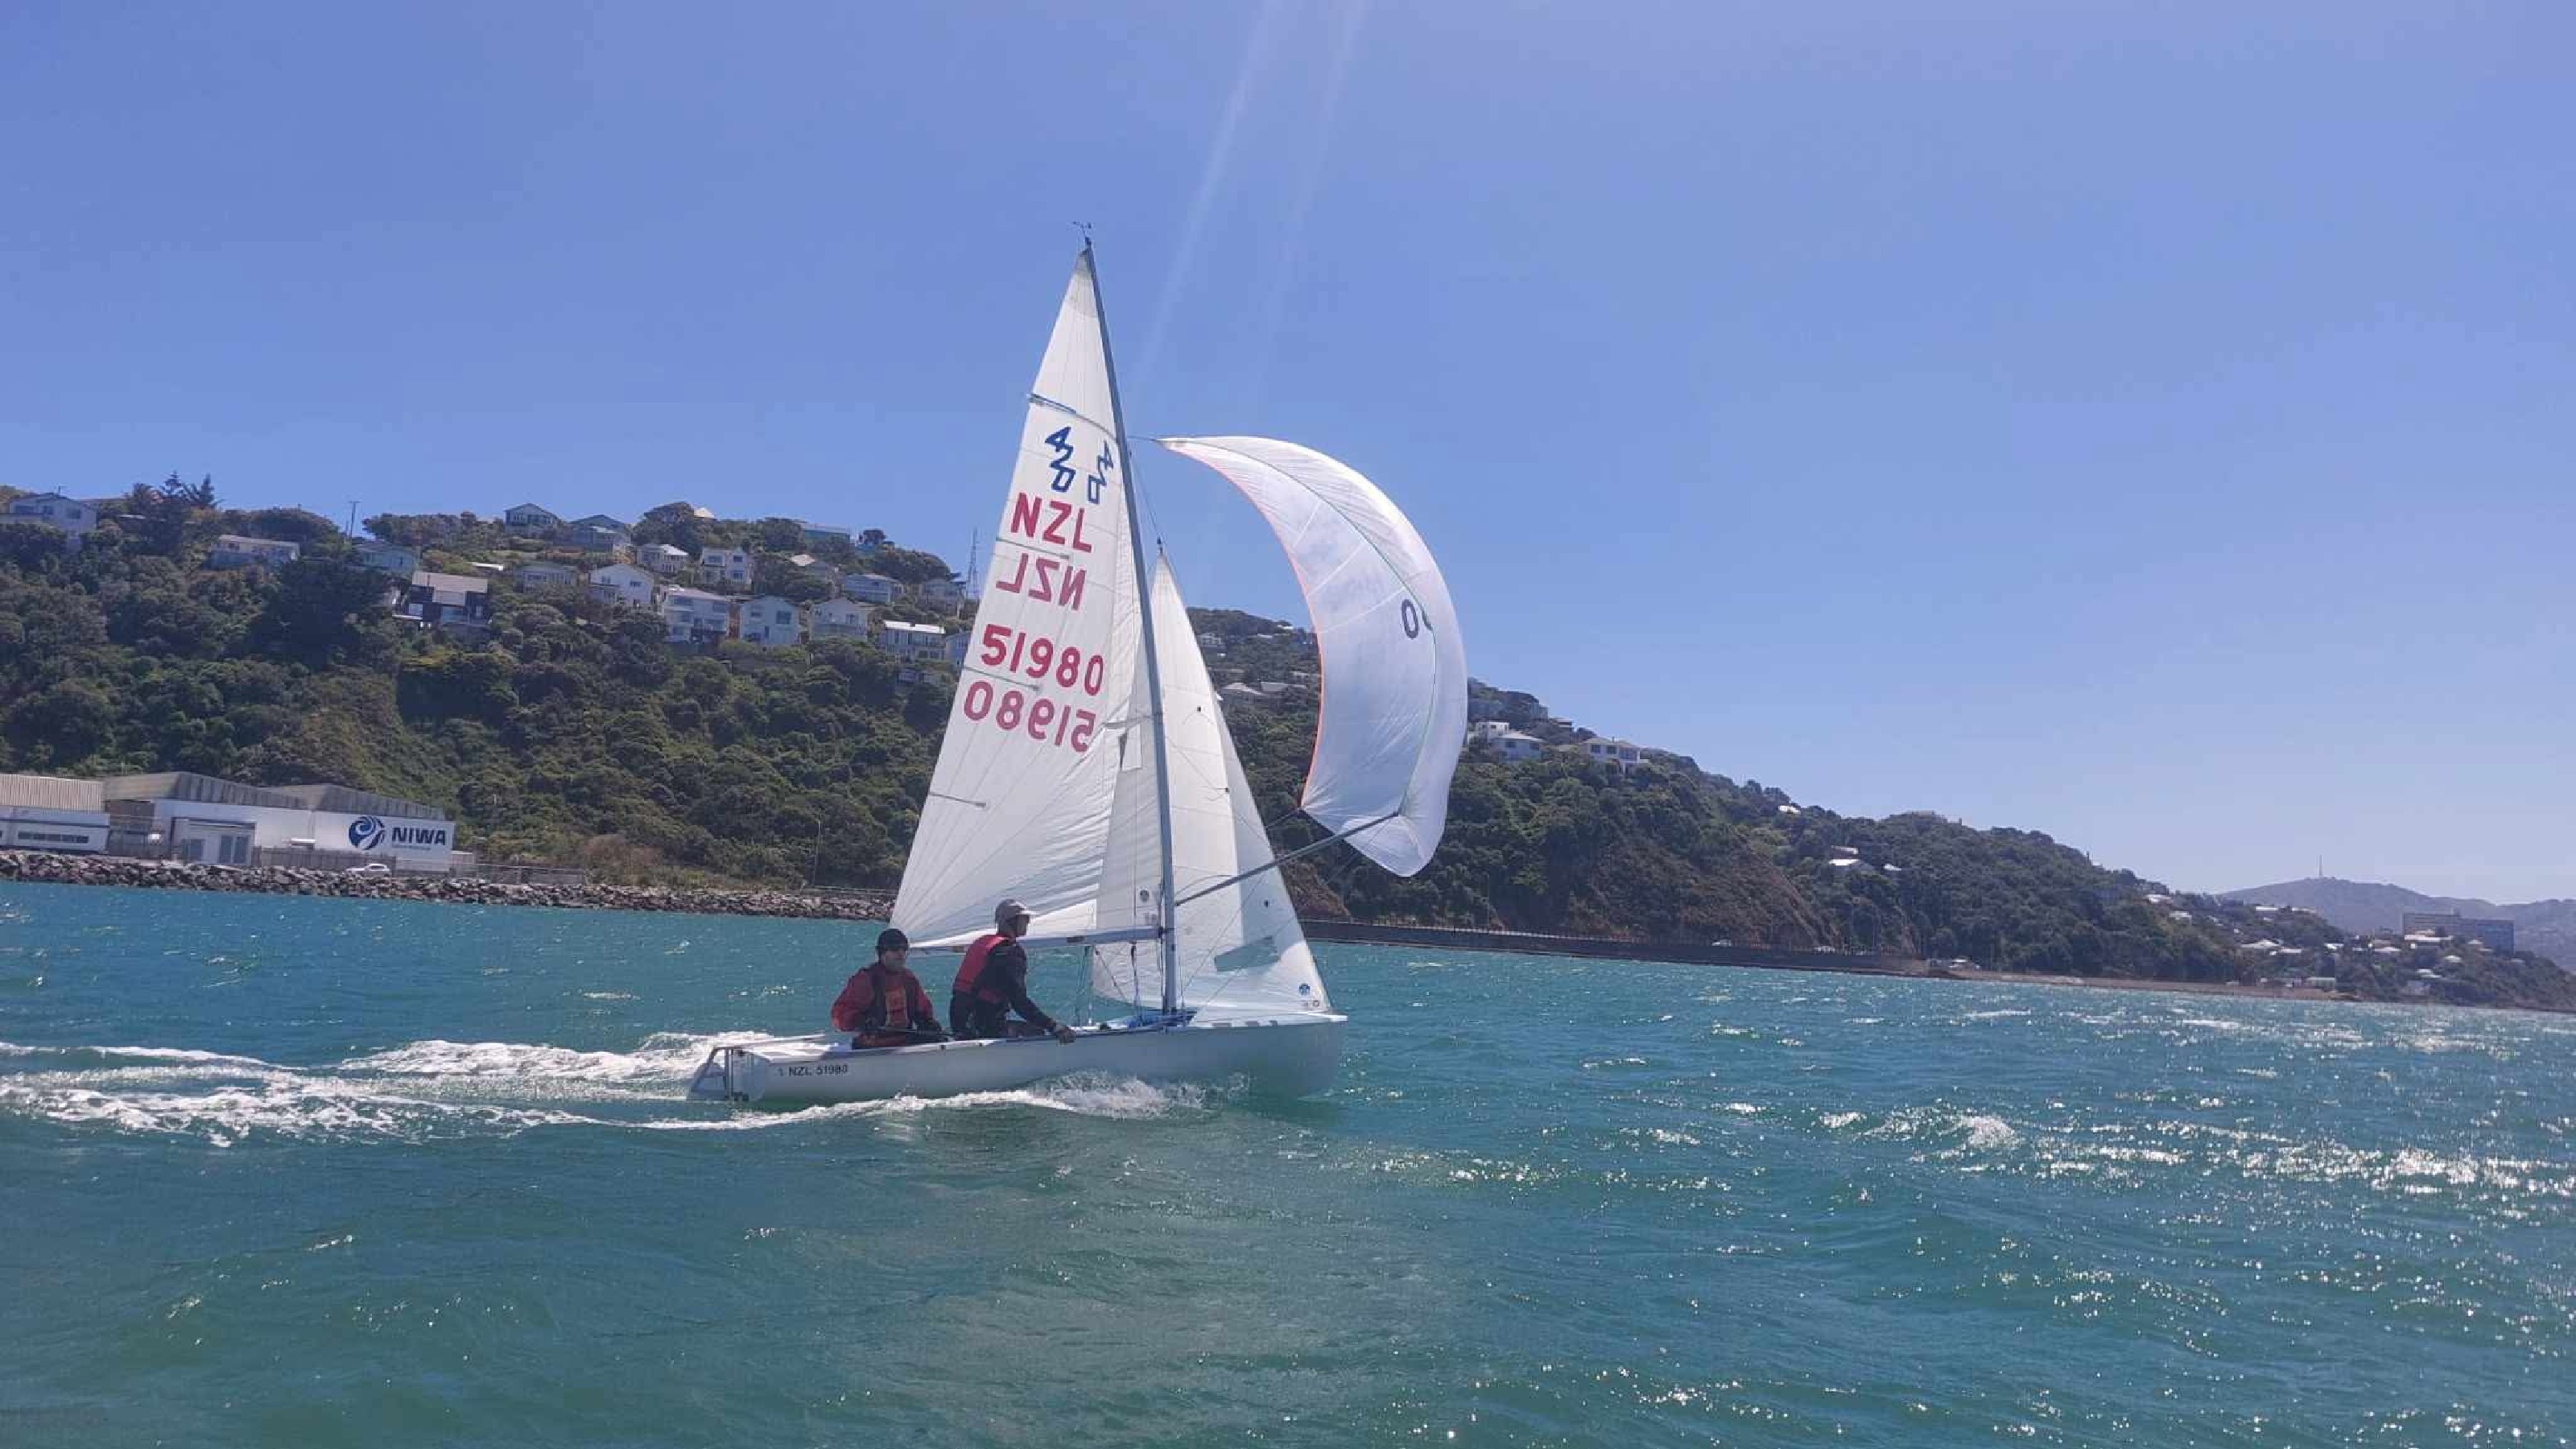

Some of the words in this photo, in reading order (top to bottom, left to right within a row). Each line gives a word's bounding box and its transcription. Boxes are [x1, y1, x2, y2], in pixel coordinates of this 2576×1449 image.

[1045, 426, 1075, 493] 420
[1010, 492, 1092, 553] NZL
[981, 623, 1104, 696] 51980
[391, 826, 447, 846] NIWA
[788, 1066, 812, 1077] NZL
